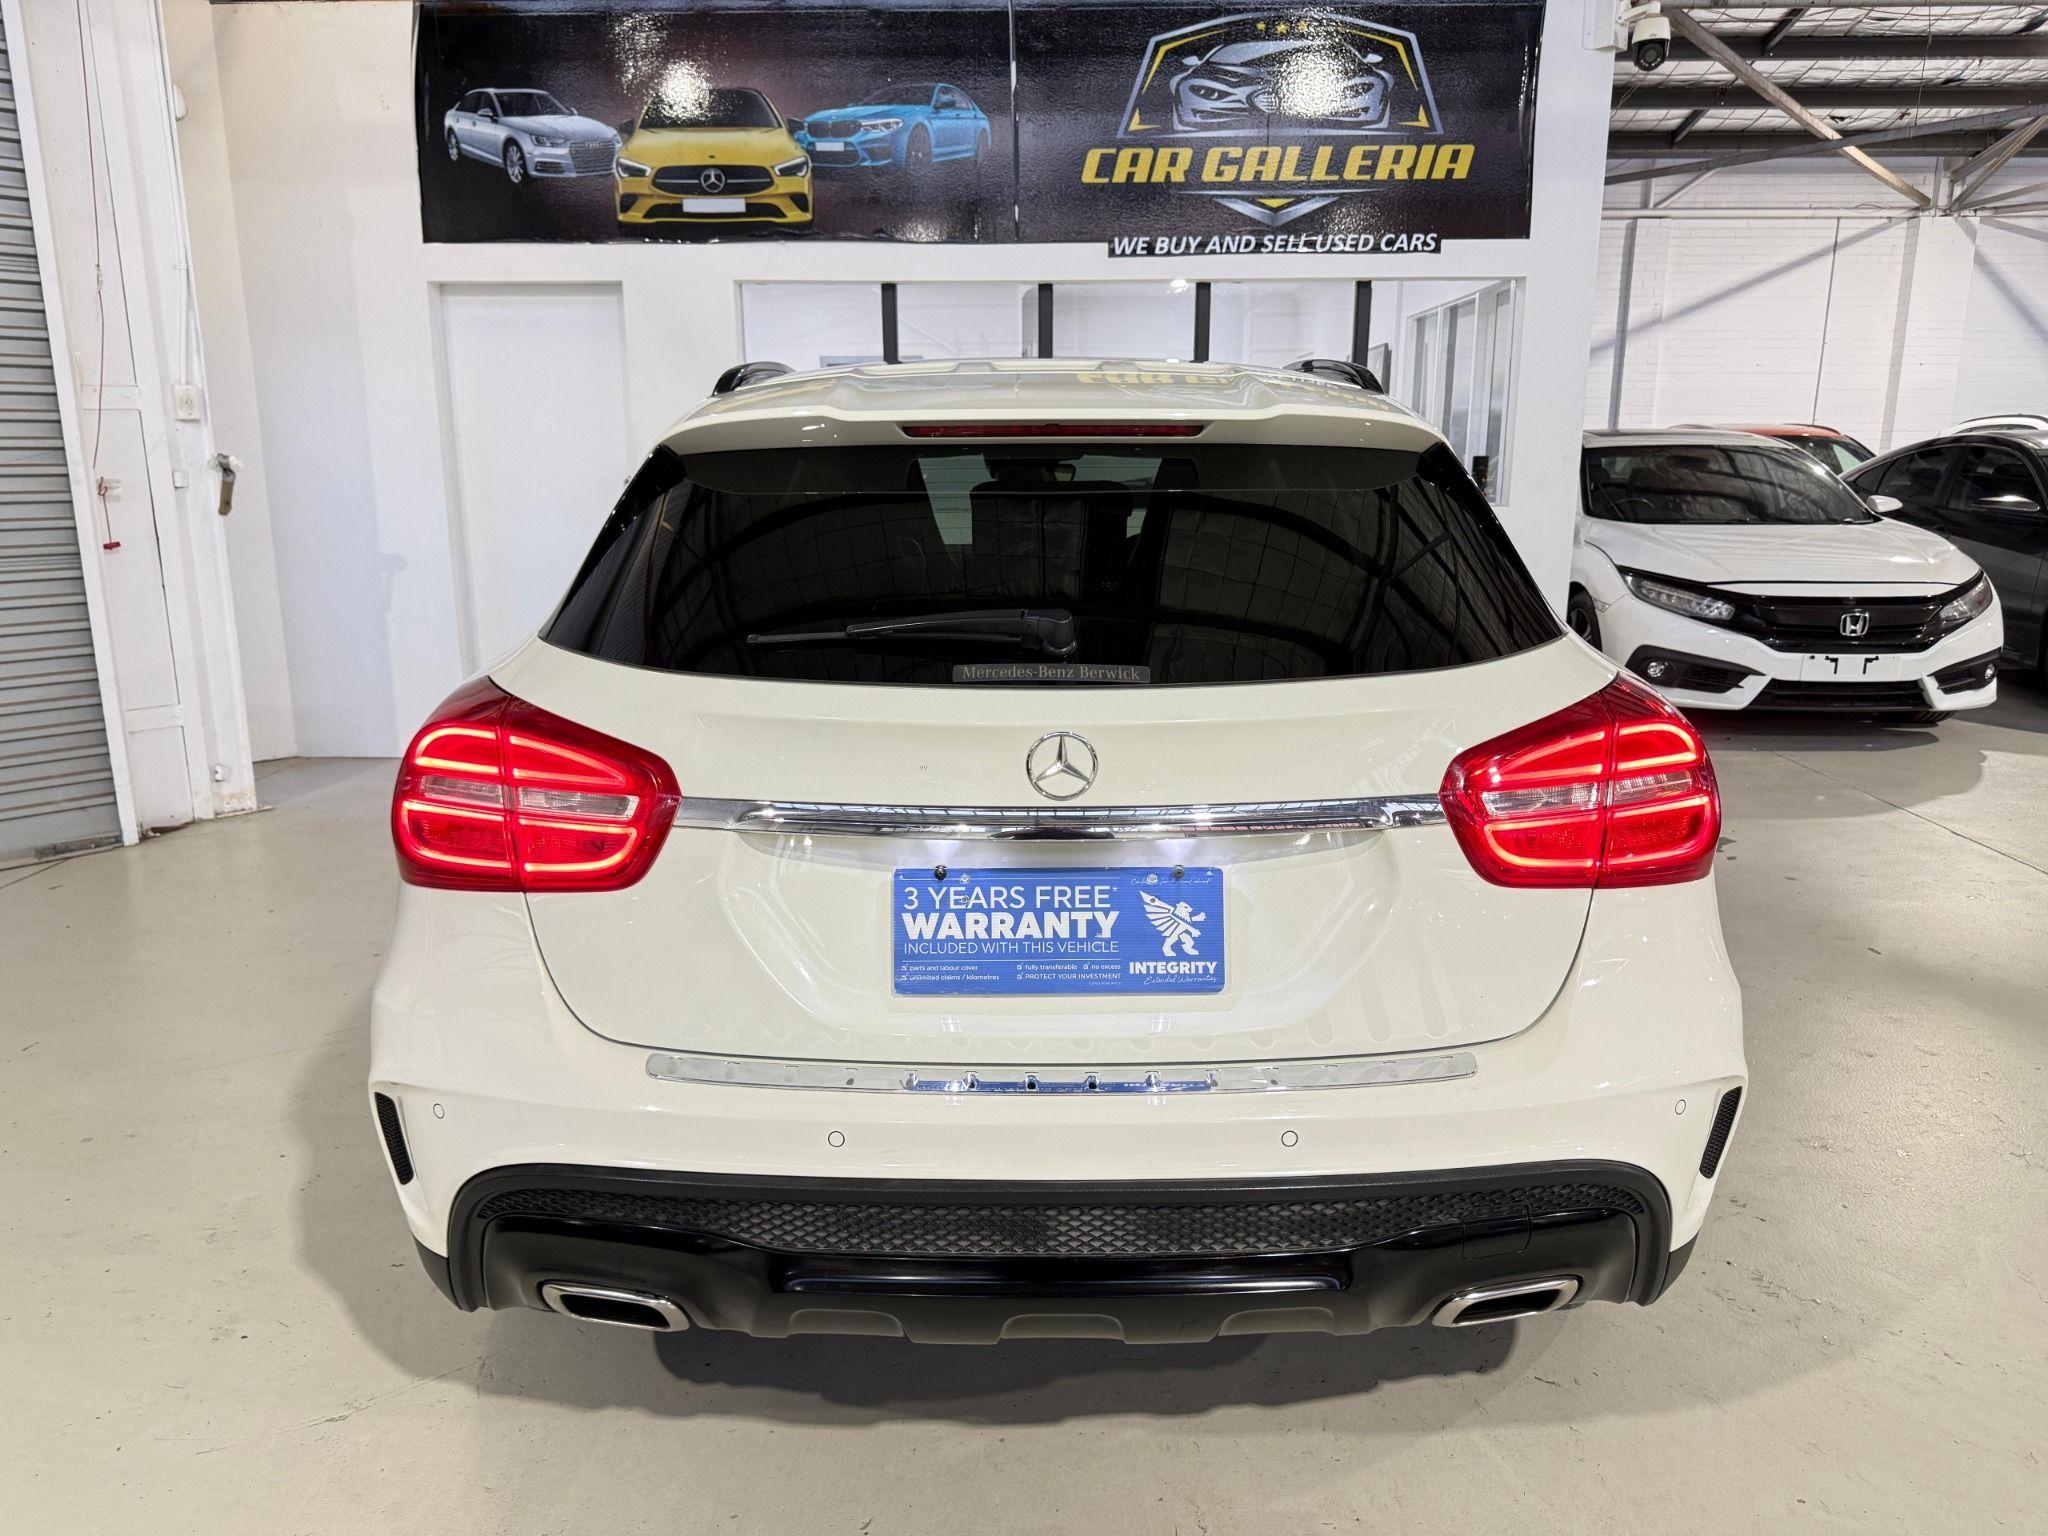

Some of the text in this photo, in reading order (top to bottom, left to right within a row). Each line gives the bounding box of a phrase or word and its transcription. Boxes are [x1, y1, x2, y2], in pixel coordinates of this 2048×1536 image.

[1081, 144, 1475, 184] CAR GALLERIA
[1113, 233, 1437, 255] WE BUY AND SELL USED CARS
[962, 666, 1140, 680] Mercedes-Benz Berwick
[904, 887, 918, 909] 3
[928, 886, 1025, 909] YEARS
[901, 911, 1120, 940] WARRANTY
[904, 940, 1119, 954] INCLUDED WITH THIS VEHICLE
[1129, 961, 1217, 974] INTEGRITY
